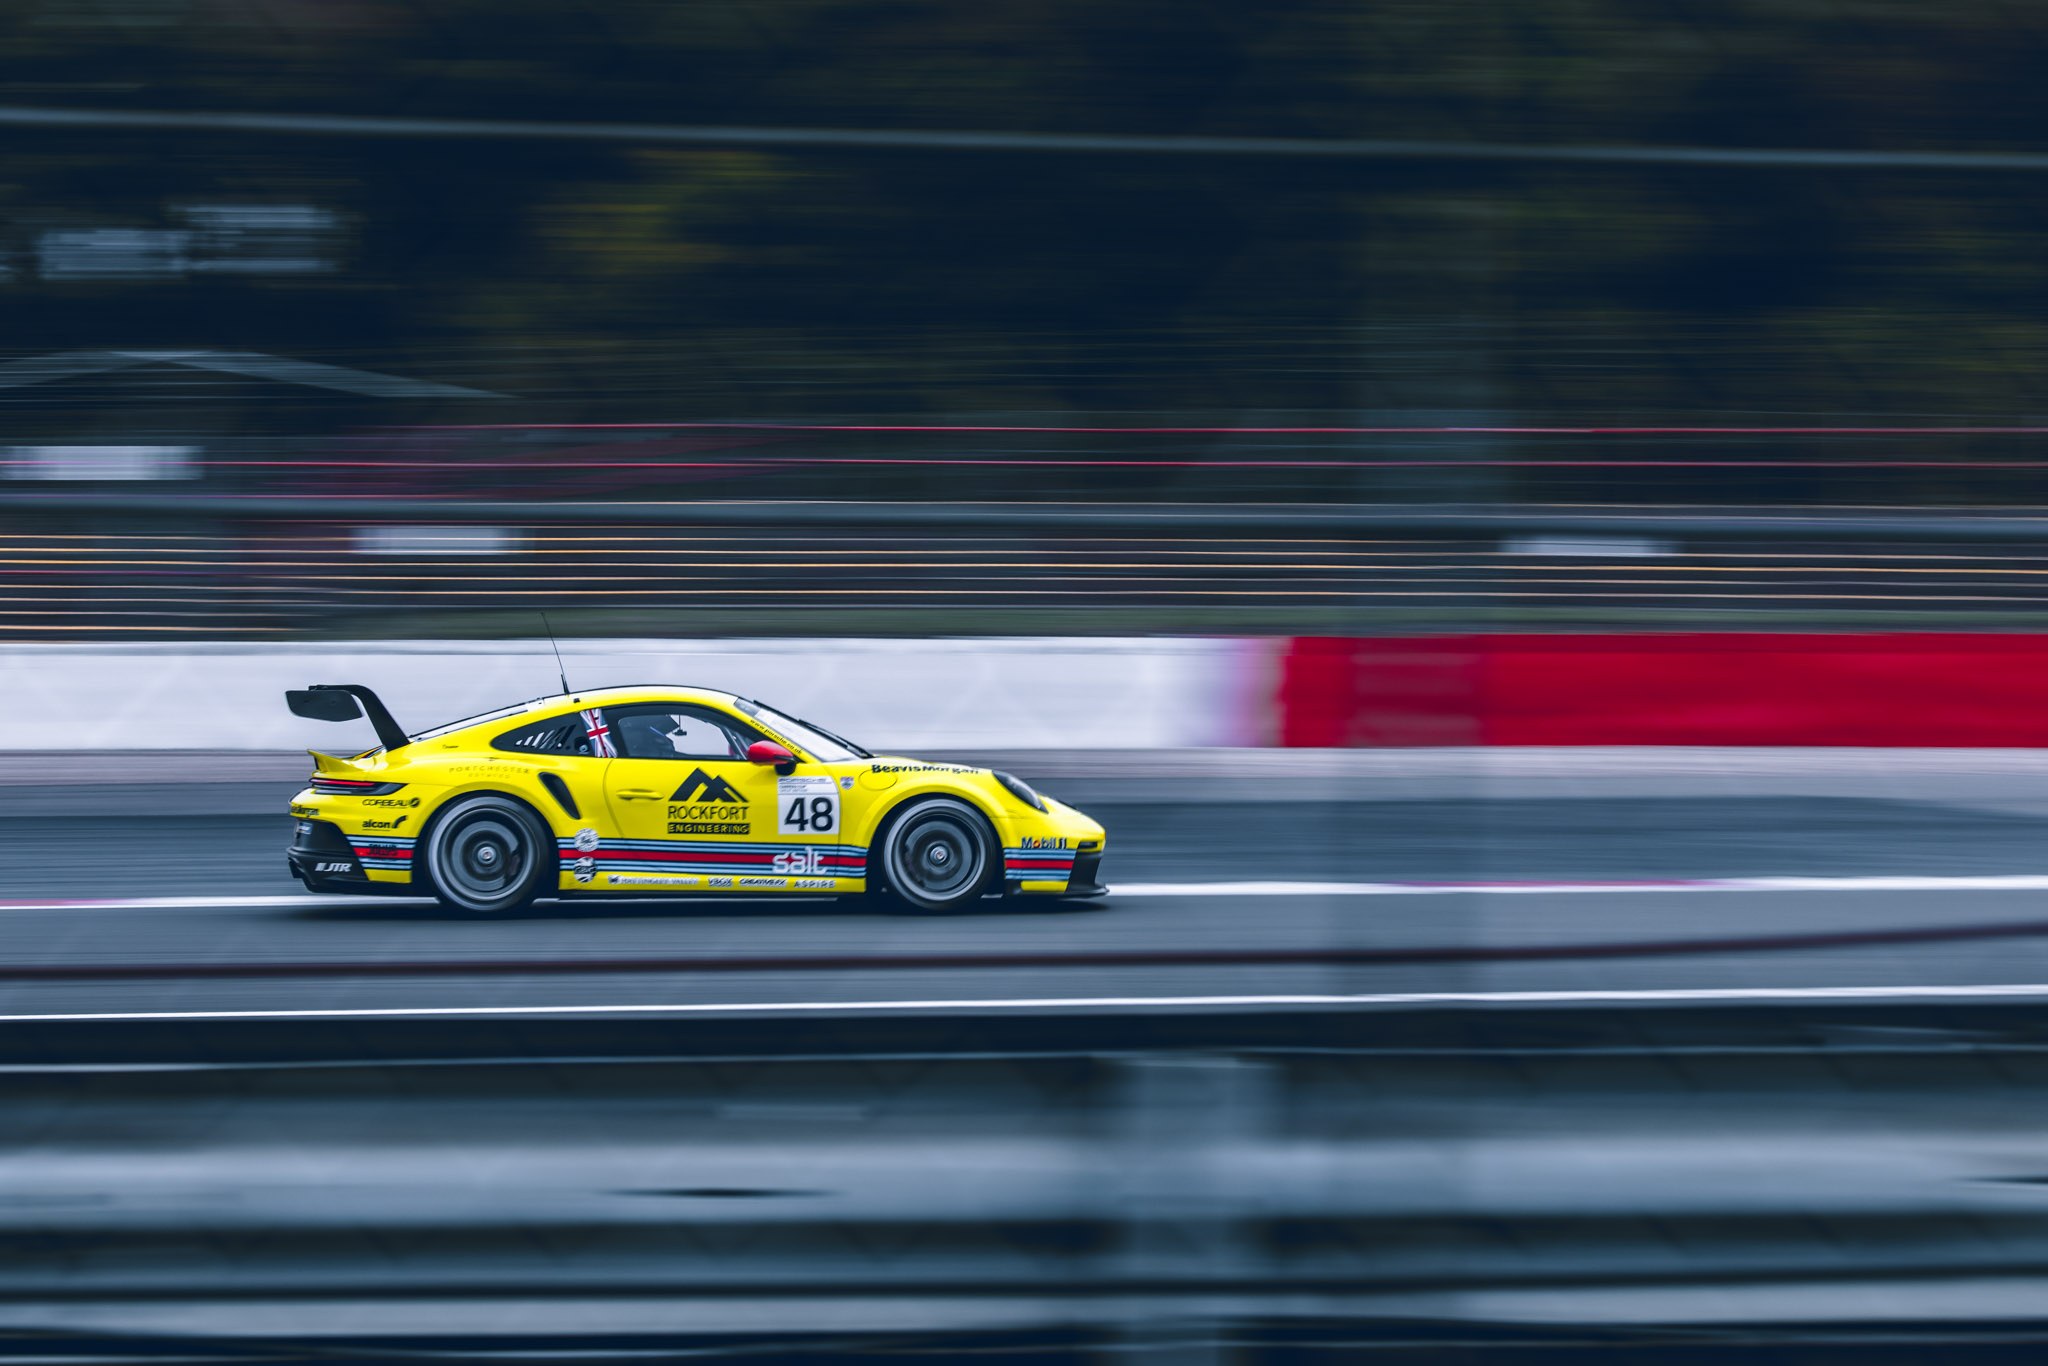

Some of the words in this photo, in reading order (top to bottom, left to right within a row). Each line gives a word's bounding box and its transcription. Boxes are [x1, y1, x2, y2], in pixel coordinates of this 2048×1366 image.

[668, 805, 750, 820] ROCKFORT
[784, 796, 833, 832] 48
[362, 819, 391, 828] alcon
[668, 823, 749, 834] ENGINEERING
[772, 845, 829, 875] salt
[794, 880, 836, 888] ASPIRE
